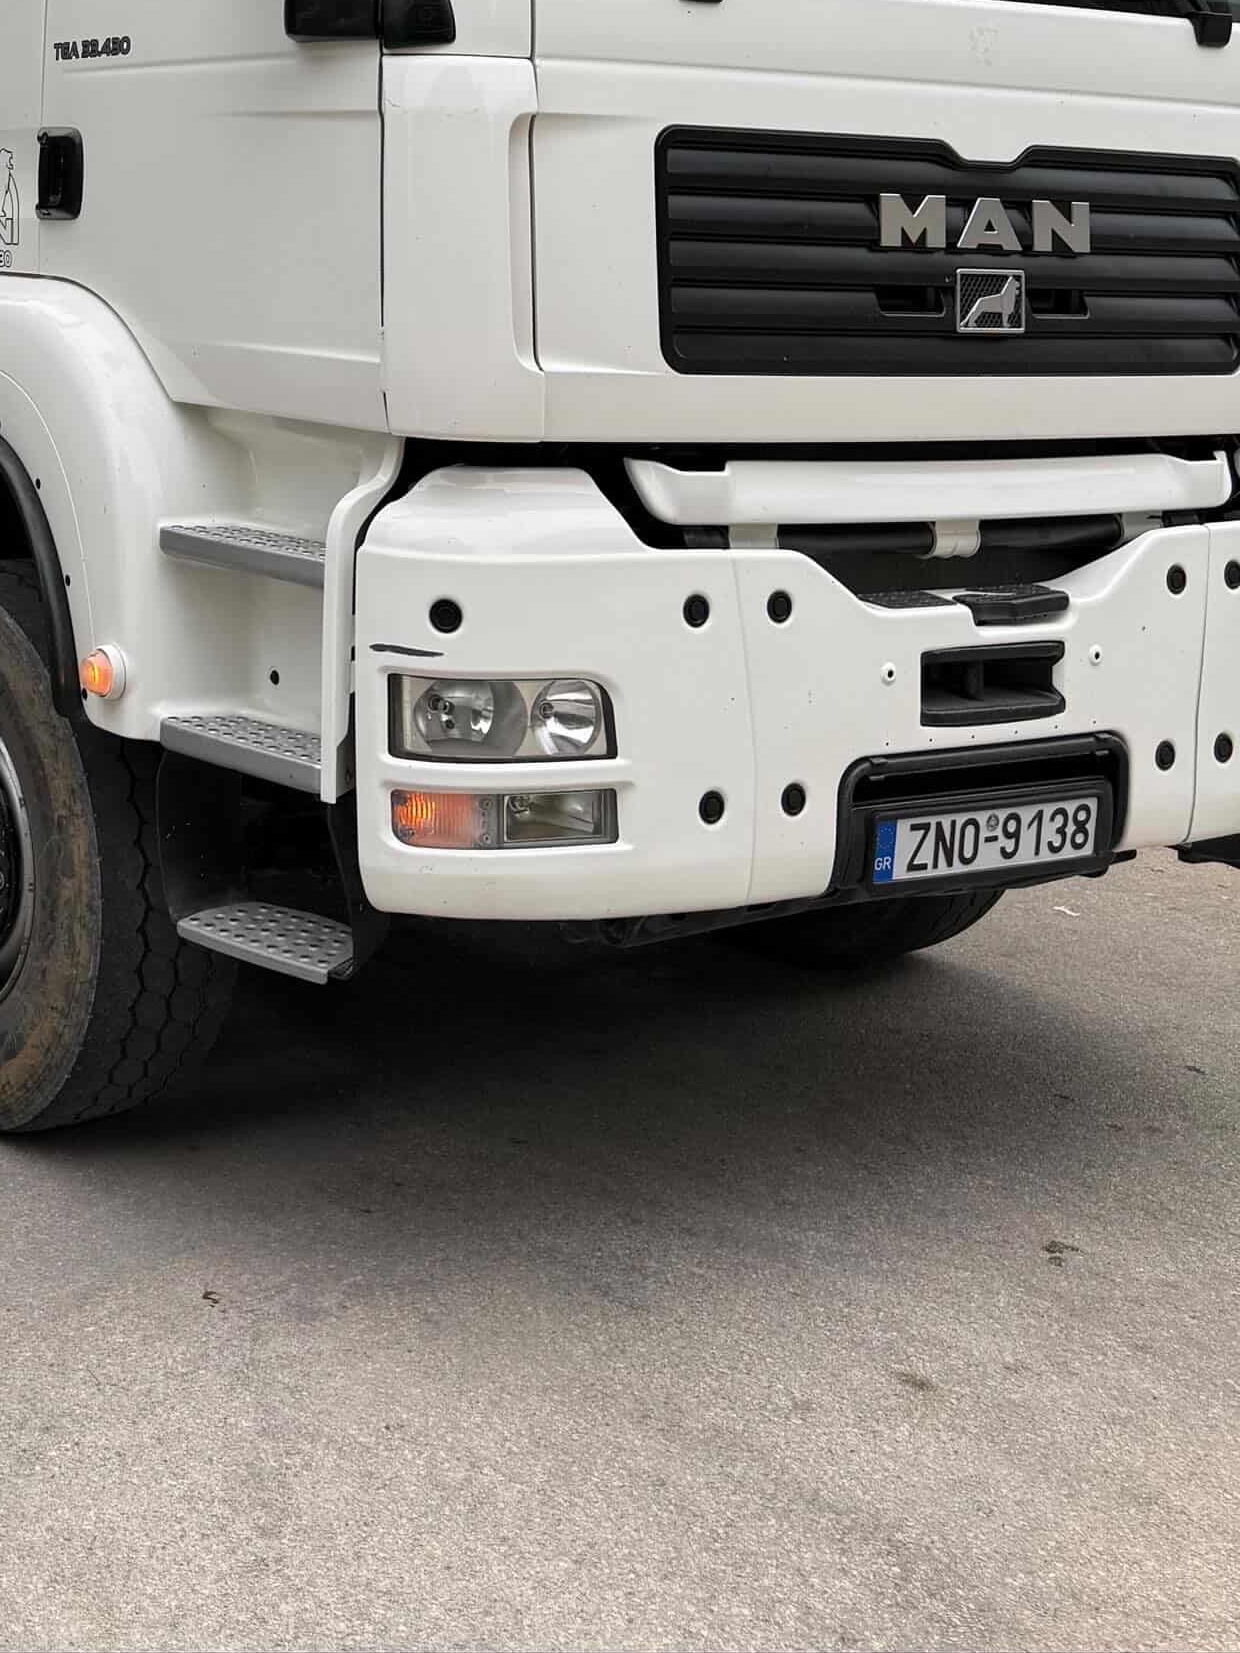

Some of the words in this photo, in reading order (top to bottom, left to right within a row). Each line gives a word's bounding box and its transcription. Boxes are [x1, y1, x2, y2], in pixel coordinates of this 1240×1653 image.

[54, 41, 79, 61] TGA
[879, 193, 1092, 253] MAN
[906, 803, 1092, 873] ZNO-9138
[874, 856, 892, 871] GR
